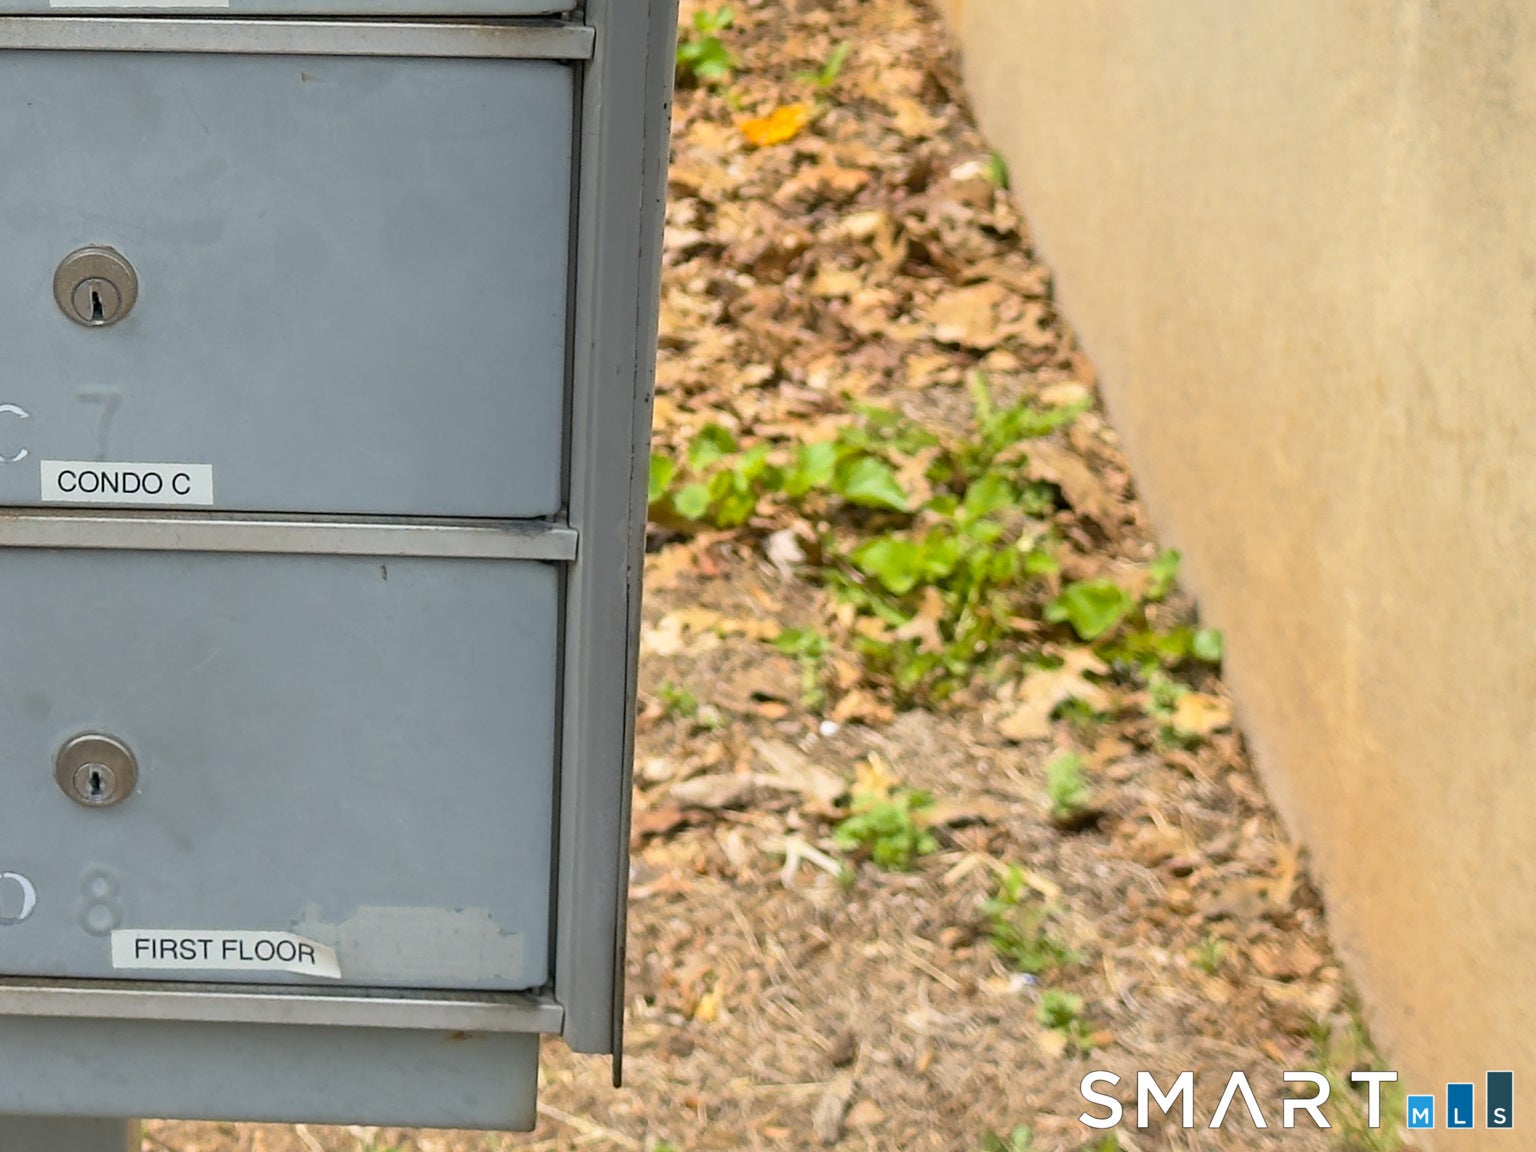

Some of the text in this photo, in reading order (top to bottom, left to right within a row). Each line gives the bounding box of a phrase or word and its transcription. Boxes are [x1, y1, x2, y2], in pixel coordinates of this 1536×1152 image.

[74, 386, 123, 460] 7
[58, 469, 191, 496] CONDO C
[77, 864, 124, 937] 8
[135, 937, 316, 965] FIRST FLOOR
